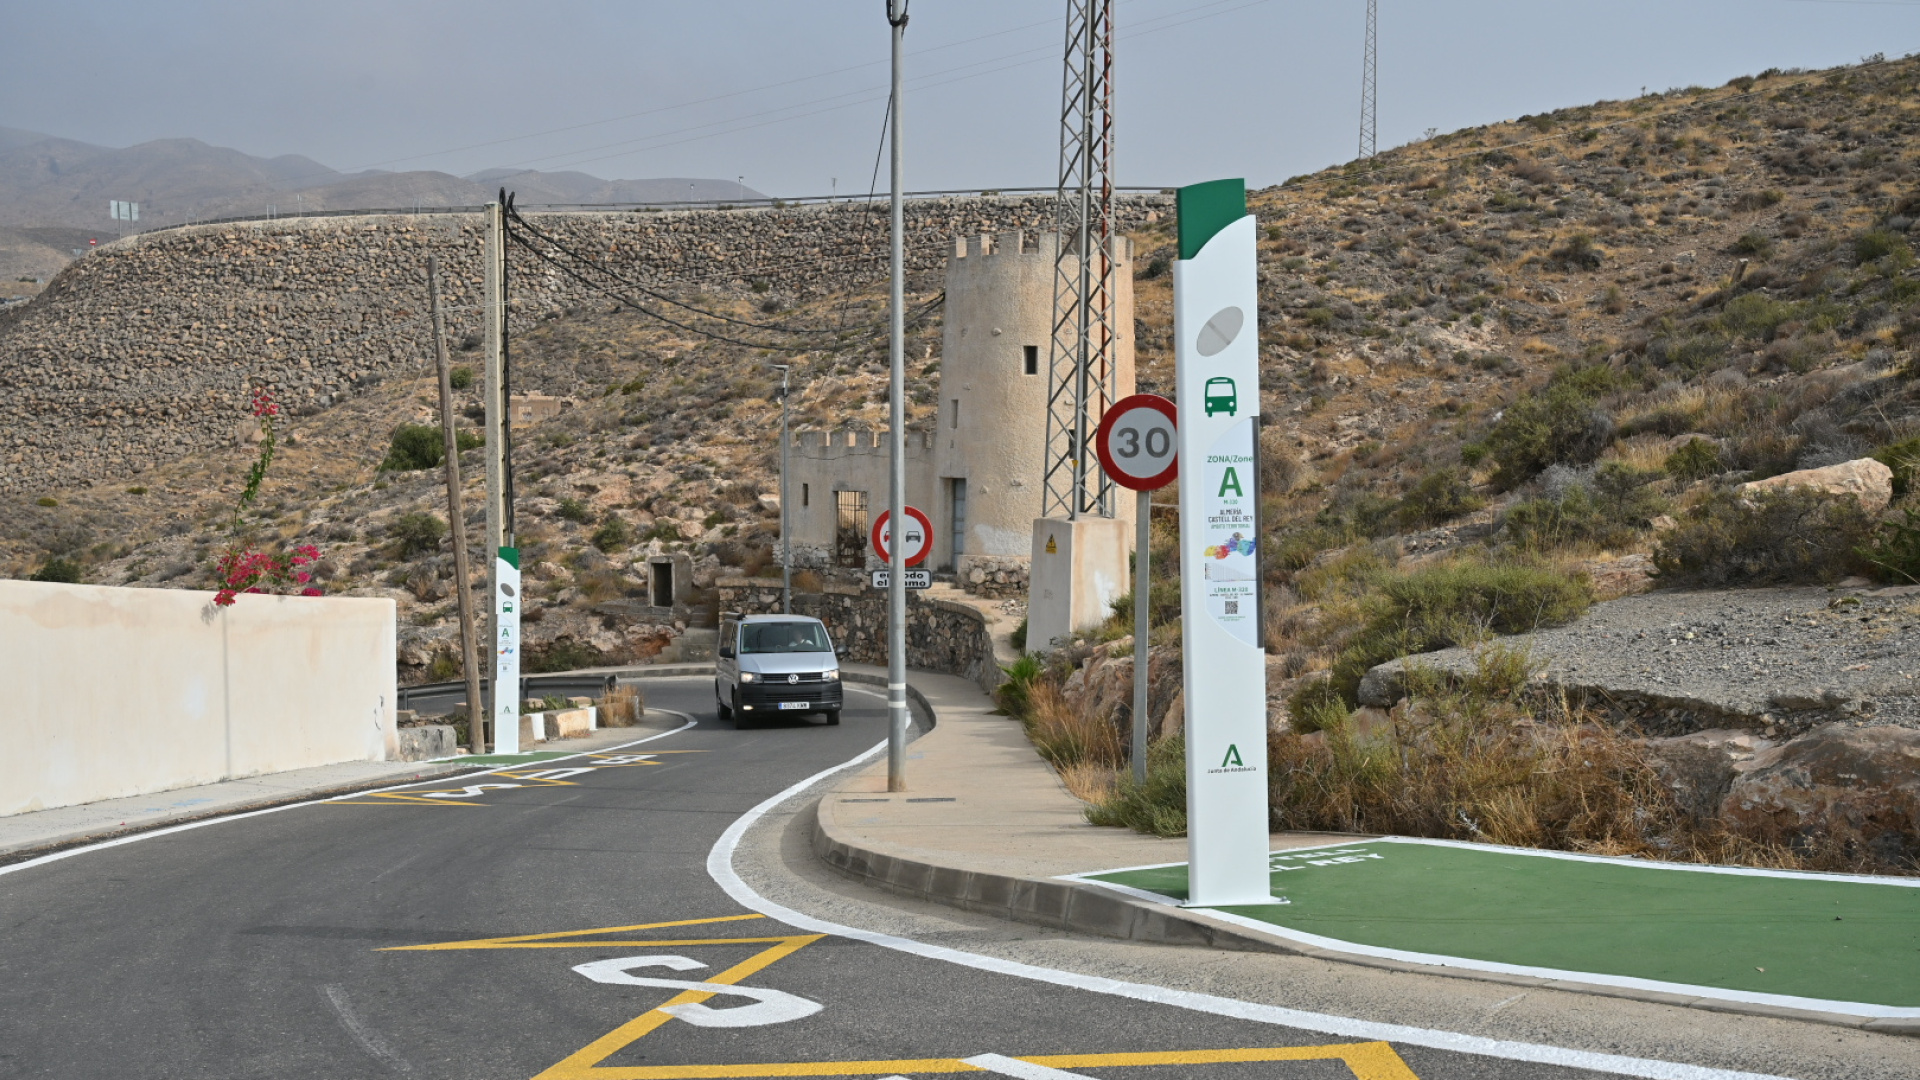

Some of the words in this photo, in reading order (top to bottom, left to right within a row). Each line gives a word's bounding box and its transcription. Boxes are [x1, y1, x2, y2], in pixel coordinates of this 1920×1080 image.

[1117, 427, 1170, 458] 30
[1207, 455, 1253, 464] ZONA/Zone
[1218, 466, 1243, 497] A
[905, 571, 924, 579] odo
